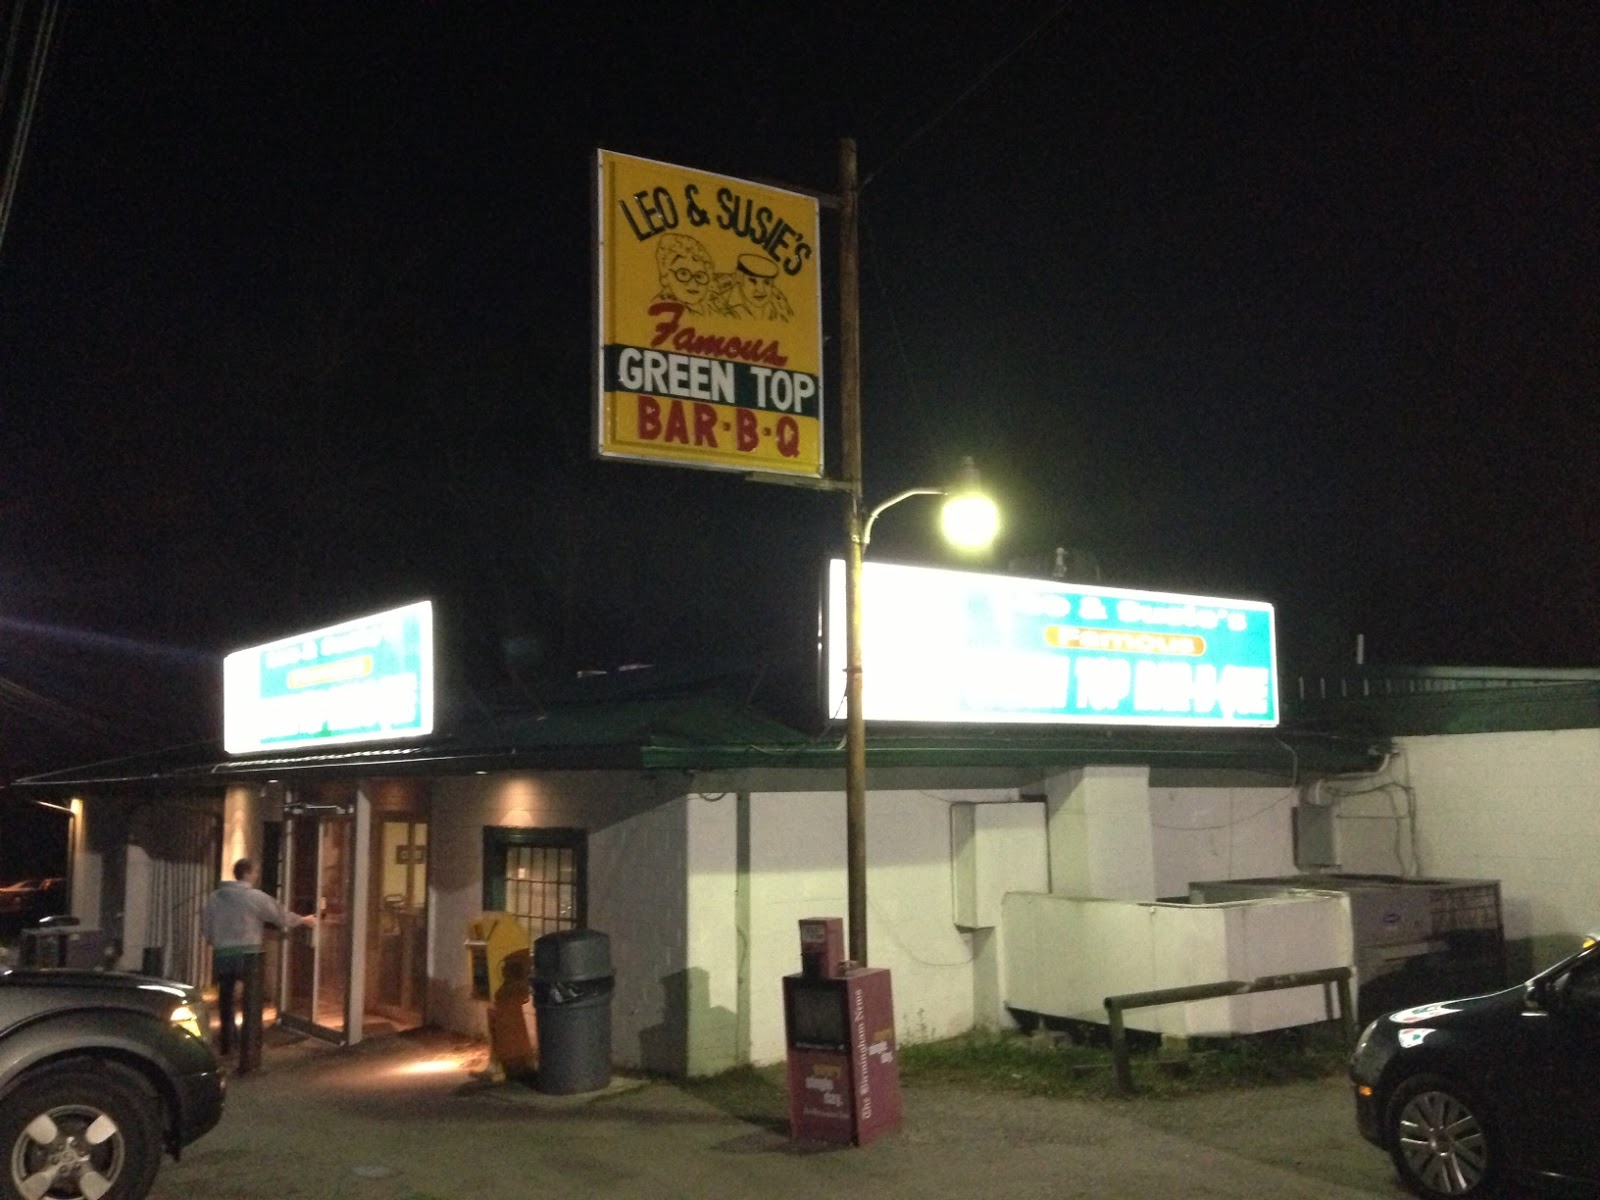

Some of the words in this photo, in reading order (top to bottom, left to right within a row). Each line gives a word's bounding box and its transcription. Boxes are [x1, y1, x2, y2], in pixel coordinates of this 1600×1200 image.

[619, 186, 679, 241] LEO
[684, 183, 710, 227] &
[716, 188, 812, 276] SUSIE'S
[647, 302, 788, 367] Famous
[618, 347, 736, 404] GREEN
[750, 366, 815, 413] TOP
[856, 1023, 870, 1096] Birmingham
